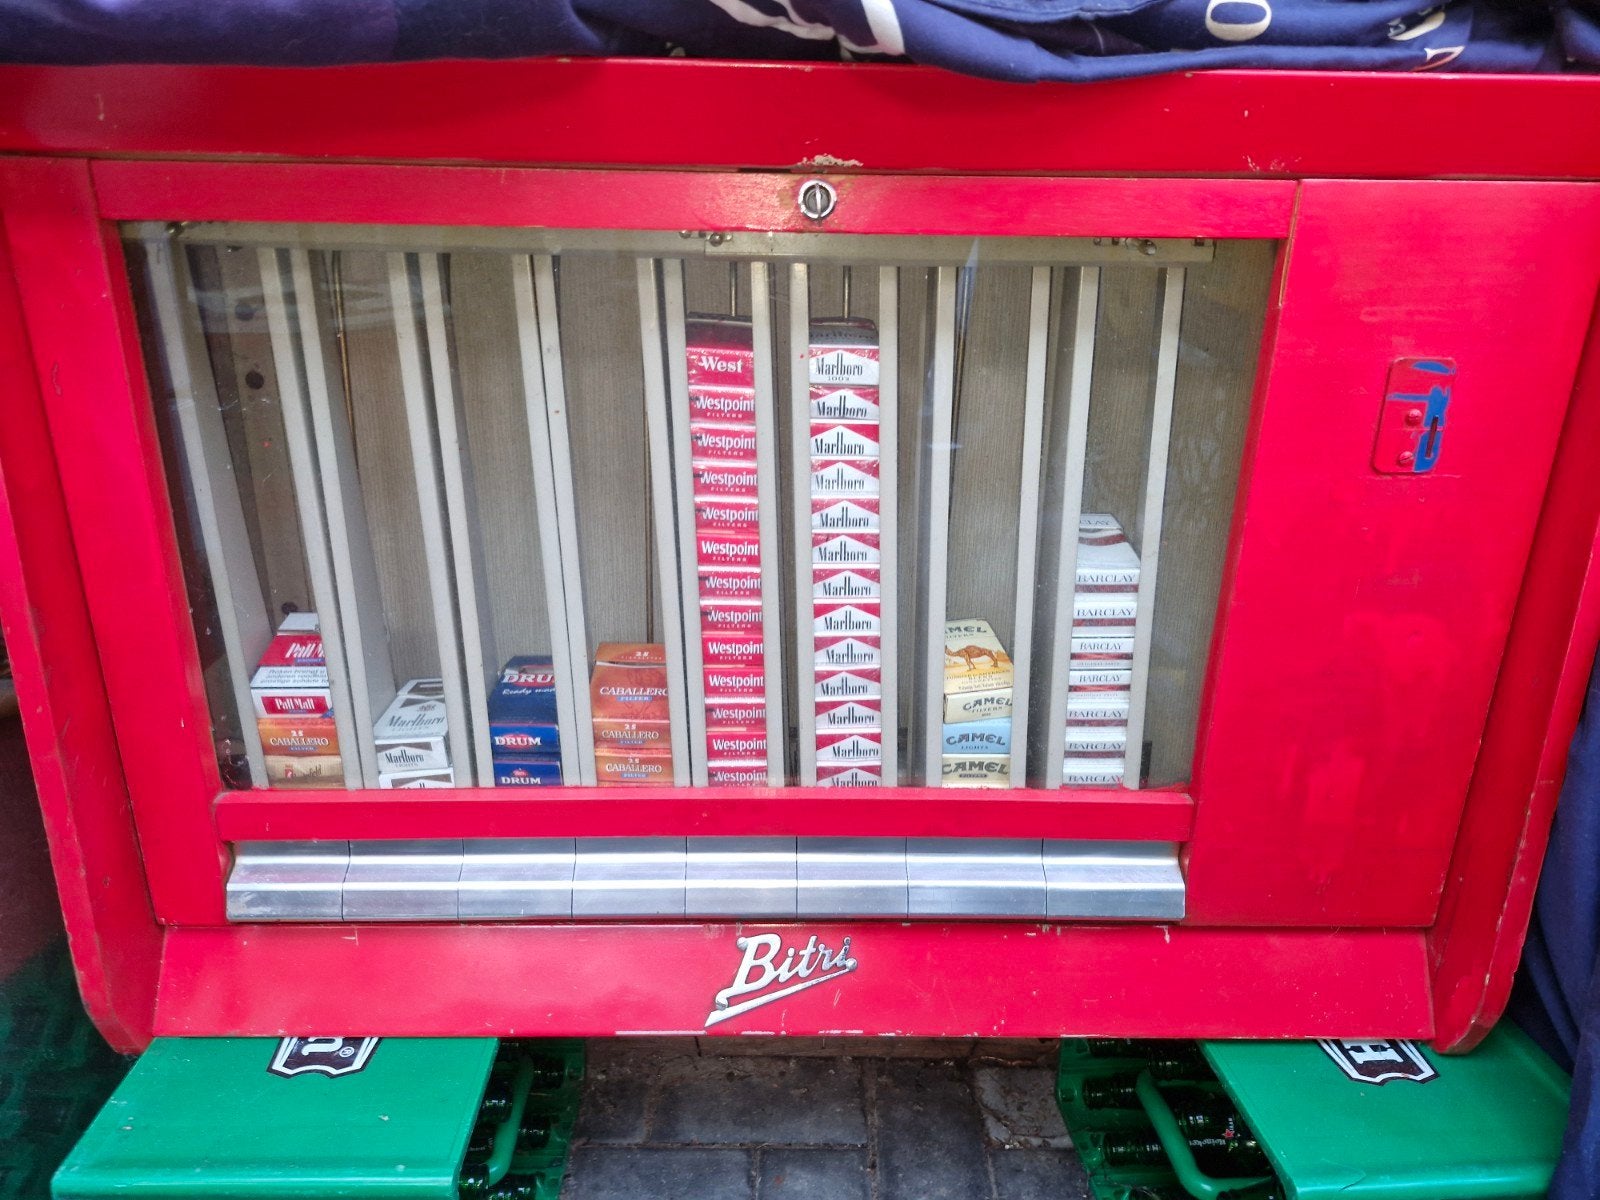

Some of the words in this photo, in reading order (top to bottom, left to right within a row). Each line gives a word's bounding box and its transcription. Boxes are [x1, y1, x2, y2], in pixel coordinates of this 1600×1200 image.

[698, 355, 742, 374] West
[816, 353, 863, 376] Marlboro
[696, 396, 754, 412] Westpoint
[817, 396, 867, 418] Marlboro
[697, 434, 756, 450] Westpoint
[815, 432, 864, 454] Marlboro
[700, 472, 757, 487] Westpoint
[815, 468, 864, 490] Marlboro
[702, 507, 758, 522] Westpoint
[820, 506, 869, 528] Marlboro
[702, 541, 758, 556] Westpoint
[818, 541, 867, 561] Marlboro
[705, 576, 761, 590] Westpoint
[1078, 574, 1135, 582] BARCLAY
[822, 576, 871, 596] Marlboro
[707, 609, 762, 624] Westpoint
[1077, 608, 1133, 616] BARCLAY
[824, 610, 872, 630] Marlboro
[286, 643, 315, 658] Pall
[708, 641, 763, 656] Westpoint
[826, 643, 874, 663] Marlboro
[1080, 642, 1122, 650] BARCLAY
[501, 673, 555, 683] DRU
[709, 674, 764, 689] Westpoint
[1079, 674, 1121, 683] BARCLAY
[821, 677, 868, 696] Marlboro
[274, 698, 294, 710] Pall
[294, 698, 315, 709] Mall
[963, 696, 1012, 711] CAMEL
[389, 713, 444, 727] Marlboro
[712, 708, 766, 720] Westpoint
[828, 707, 874, 725] Marlboro
[1069, 710, 1124, 718] BARCLAY
[270, 738, 329, 746] CABALLERO
[494, 736, 542, 746] DRUM
[602, 731, 659, 739] CABALLERO
[946, 733, 1006, 746] CAMEL
[713, 738, 766, 752] Westpoint
[832, 740, 878, 758] Marlboro
[1069, 742, 1123, 750] BARCLAY
[385, 750, 424, 763] Marlboro
[606, 763, 662, 773] CABALLERO
[942, 761, 1008, 775] CAMEL
[714, 933, 858, 1011] Bitri
